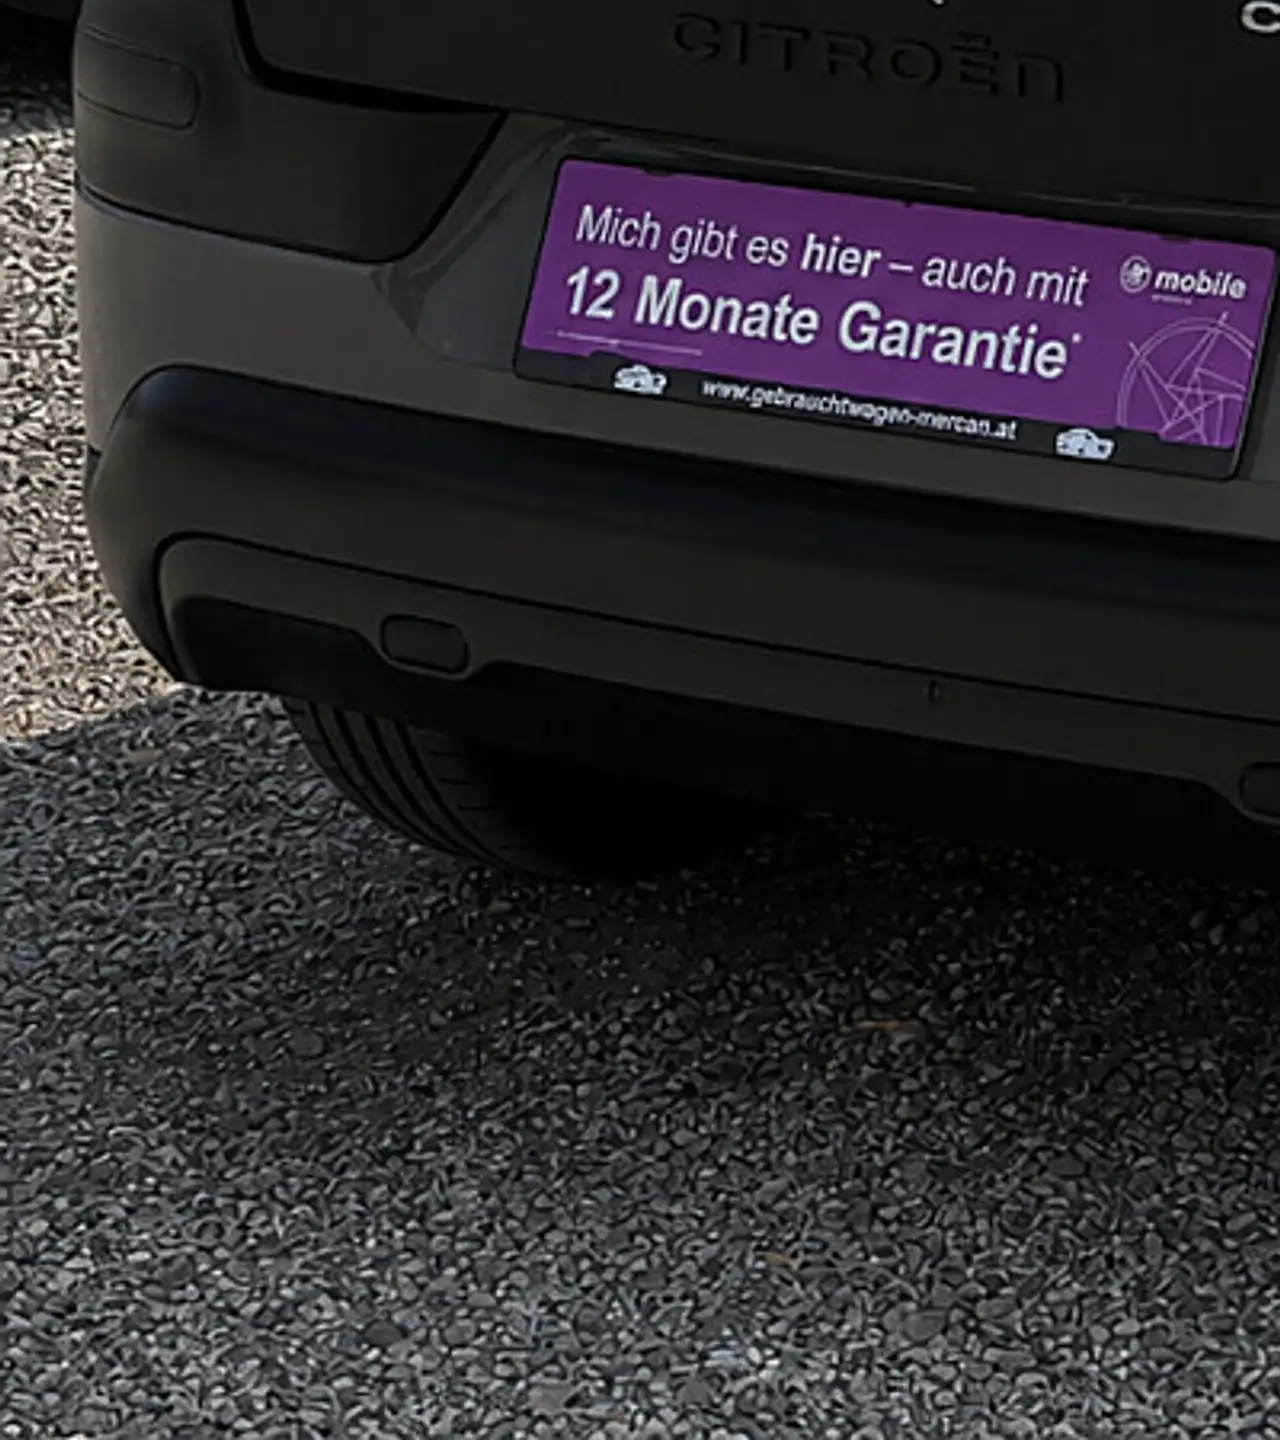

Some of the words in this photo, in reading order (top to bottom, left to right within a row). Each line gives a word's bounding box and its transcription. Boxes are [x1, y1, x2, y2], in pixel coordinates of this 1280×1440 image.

[576, 204, 661, 250] Mich
[668, 218, 738, 264] gibt
[746, 235, 790, 267] es
[800, 233, 882, 278] hier
[922, 257, 1017, 296] auch
[1026, 265, 1089, 307] mit
[1154, 268, 1247, 299] mobile
[567, 265, 620, 319] 12
[634, 274, 819, 345] Monate
